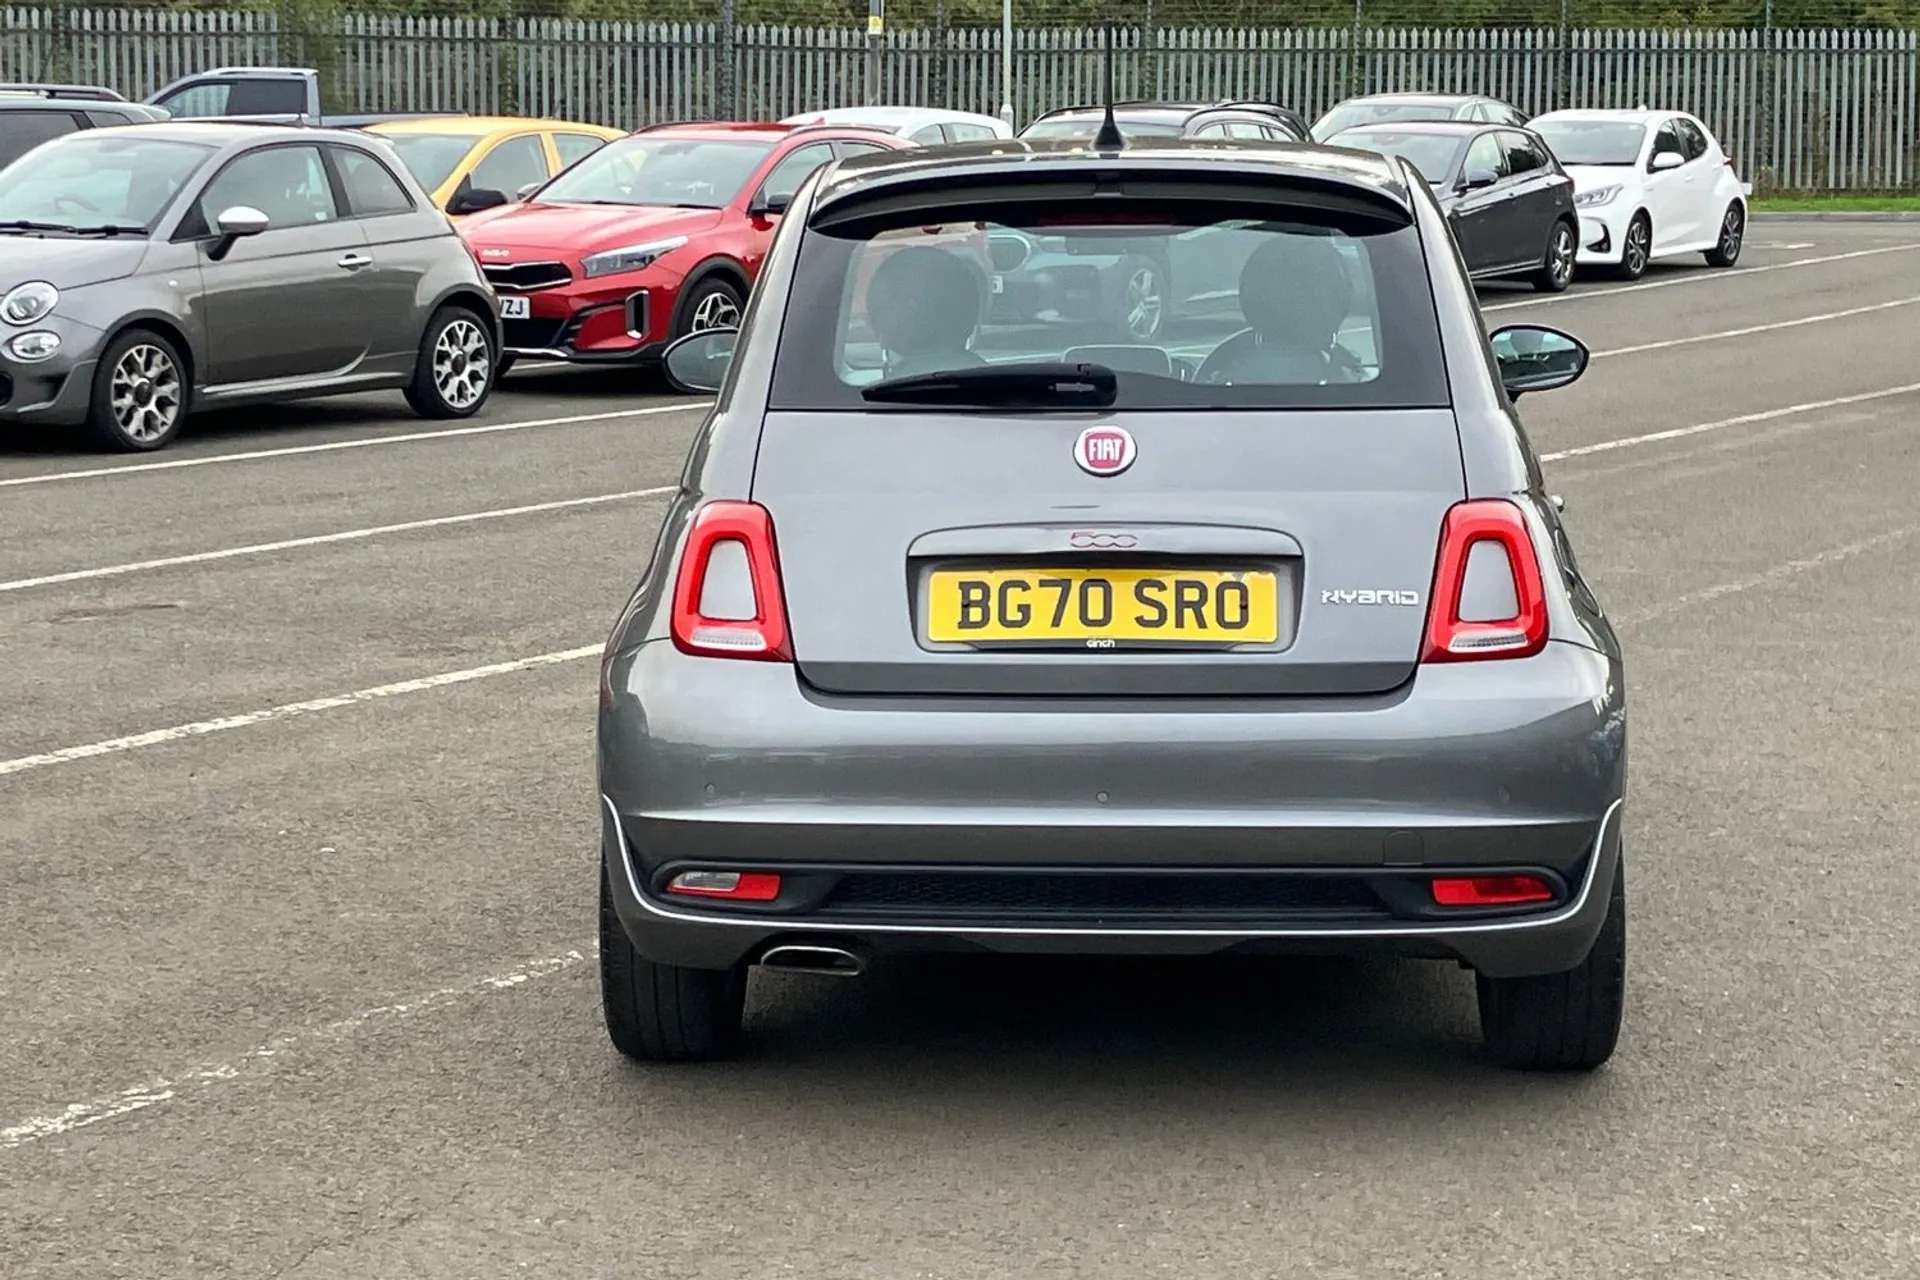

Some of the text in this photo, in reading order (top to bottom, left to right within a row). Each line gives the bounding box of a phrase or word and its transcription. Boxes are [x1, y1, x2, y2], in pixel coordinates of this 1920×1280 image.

[1088, 438, 1123, 462] FIAT
[1070, 531, 1138, 548] 500
[957, 578, 1249, 630] BG70 SRO
[1321, 589, 1419, 606] HYBRID
[1086, 637, 1116, 649] cinch
